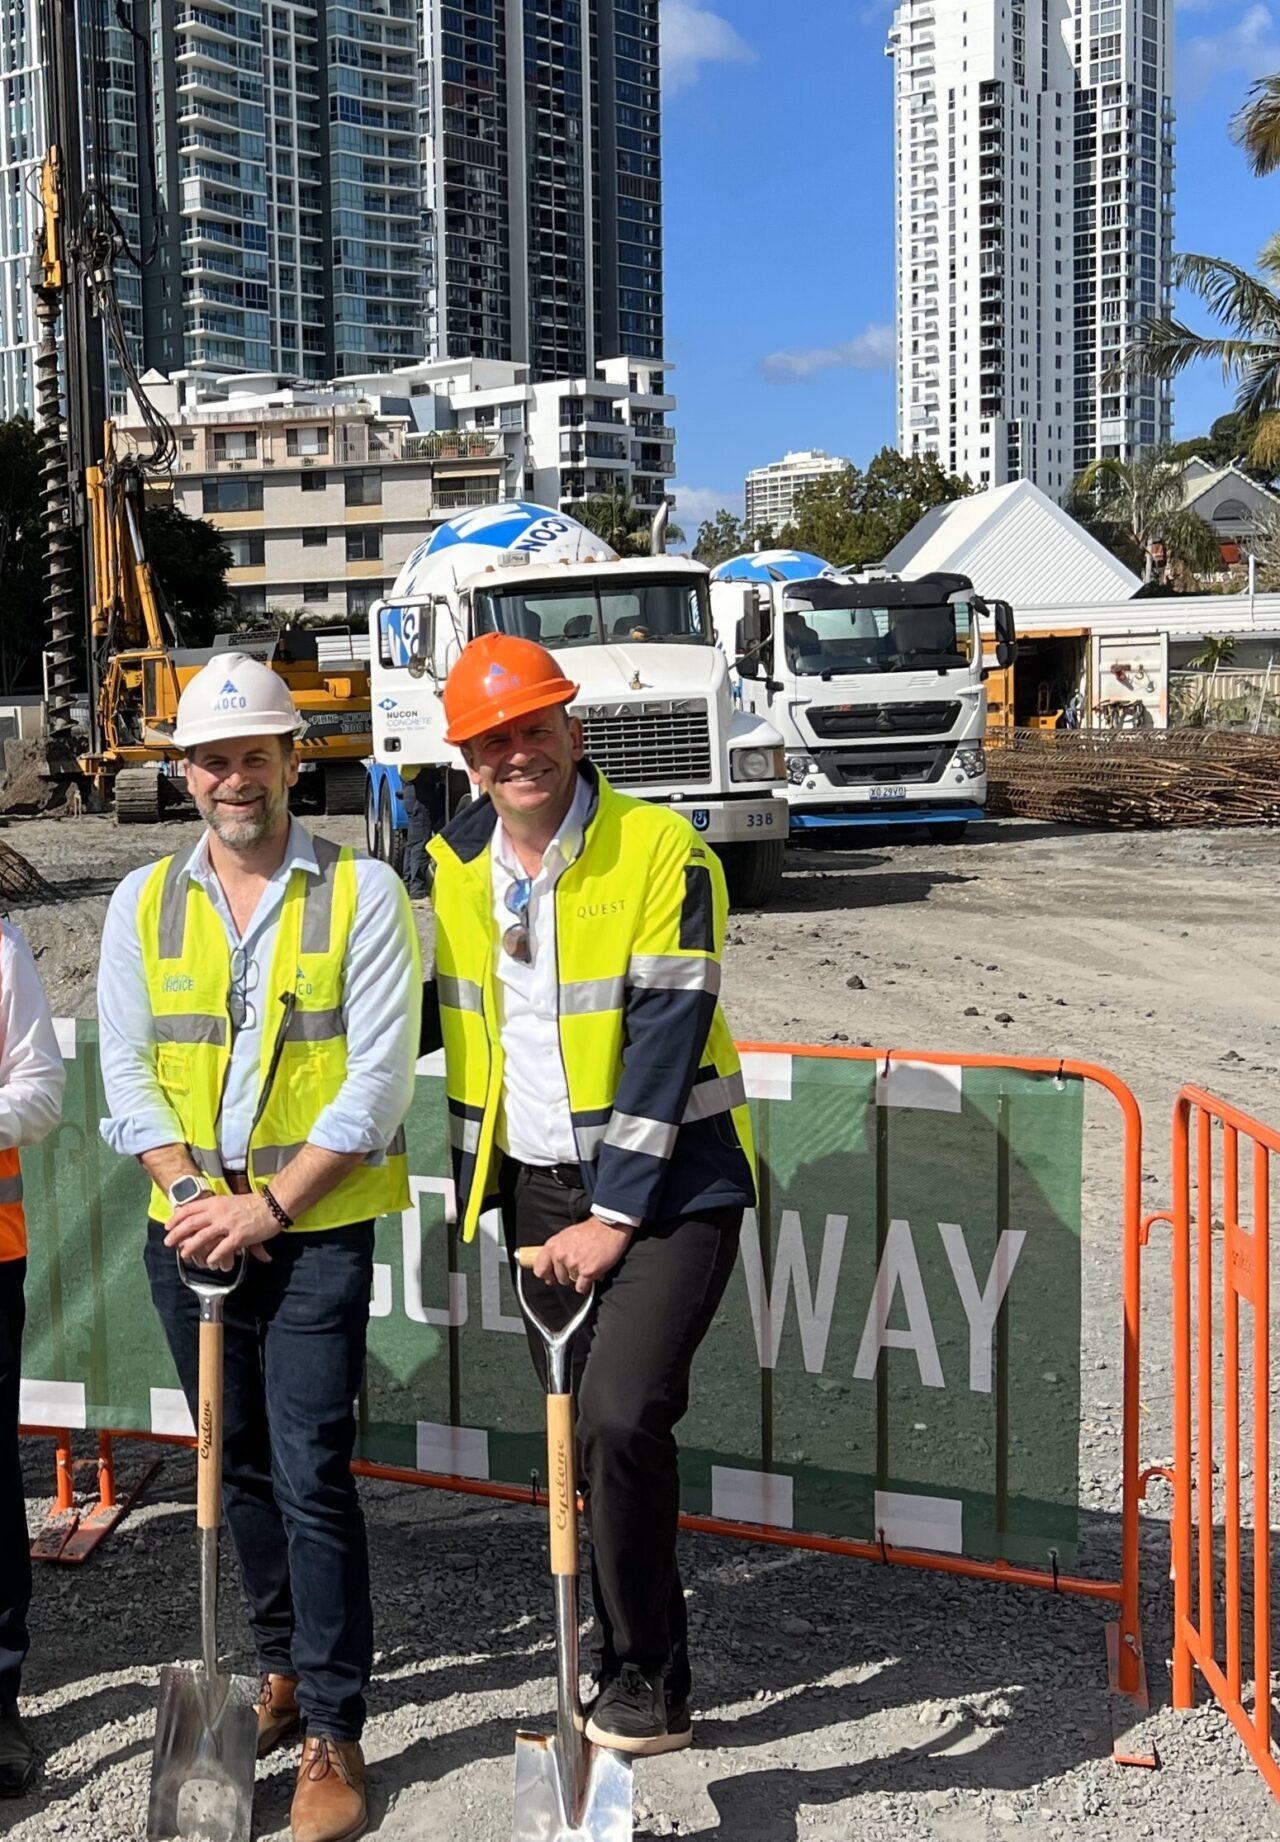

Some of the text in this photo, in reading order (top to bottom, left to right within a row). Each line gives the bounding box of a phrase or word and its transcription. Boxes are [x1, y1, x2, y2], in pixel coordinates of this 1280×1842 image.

[515, 519, 570, 552] CON
[214, 696, 247, 710] ADCO
[386, 710, 418, 719] NUCON
[386, 716, 432, 728] CONCRETE
[746, 812, 773, 828] 338
[577, 899, 626, 918] QUEST
[739, 1206, 1027, 1393] WAY
[200, 1400, 212, 1460] Cyclone
[555, 1440, 569, 1530] Cyclone
